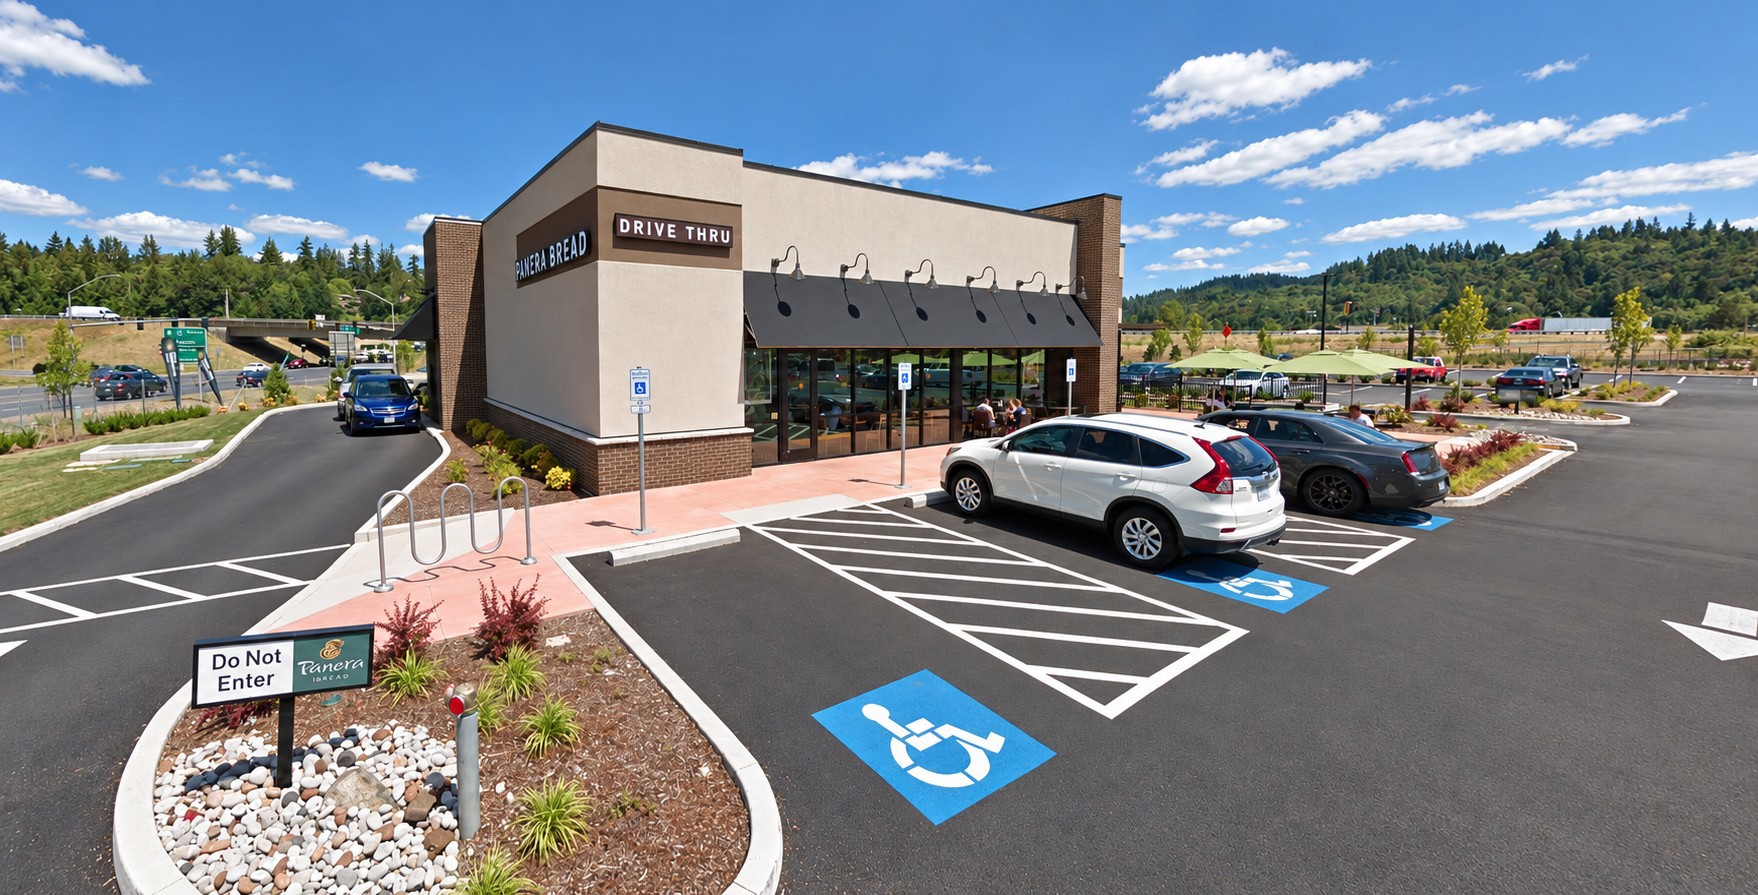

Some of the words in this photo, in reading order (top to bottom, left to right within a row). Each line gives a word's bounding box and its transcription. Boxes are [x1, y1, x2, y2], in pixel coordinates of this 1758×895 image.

[619, 218, 677, 239] DRIVE
[685, 226, 731, 244] THRU
[515, 249, 547, 281] PANERA
[549, 230, 587, 268] BREAD
[212, 654, 240, 671] Do
[246, 648, 282, 667] Not
[297, 658, 364, 676] Panera
[218, 673, 275, 692] Enter
